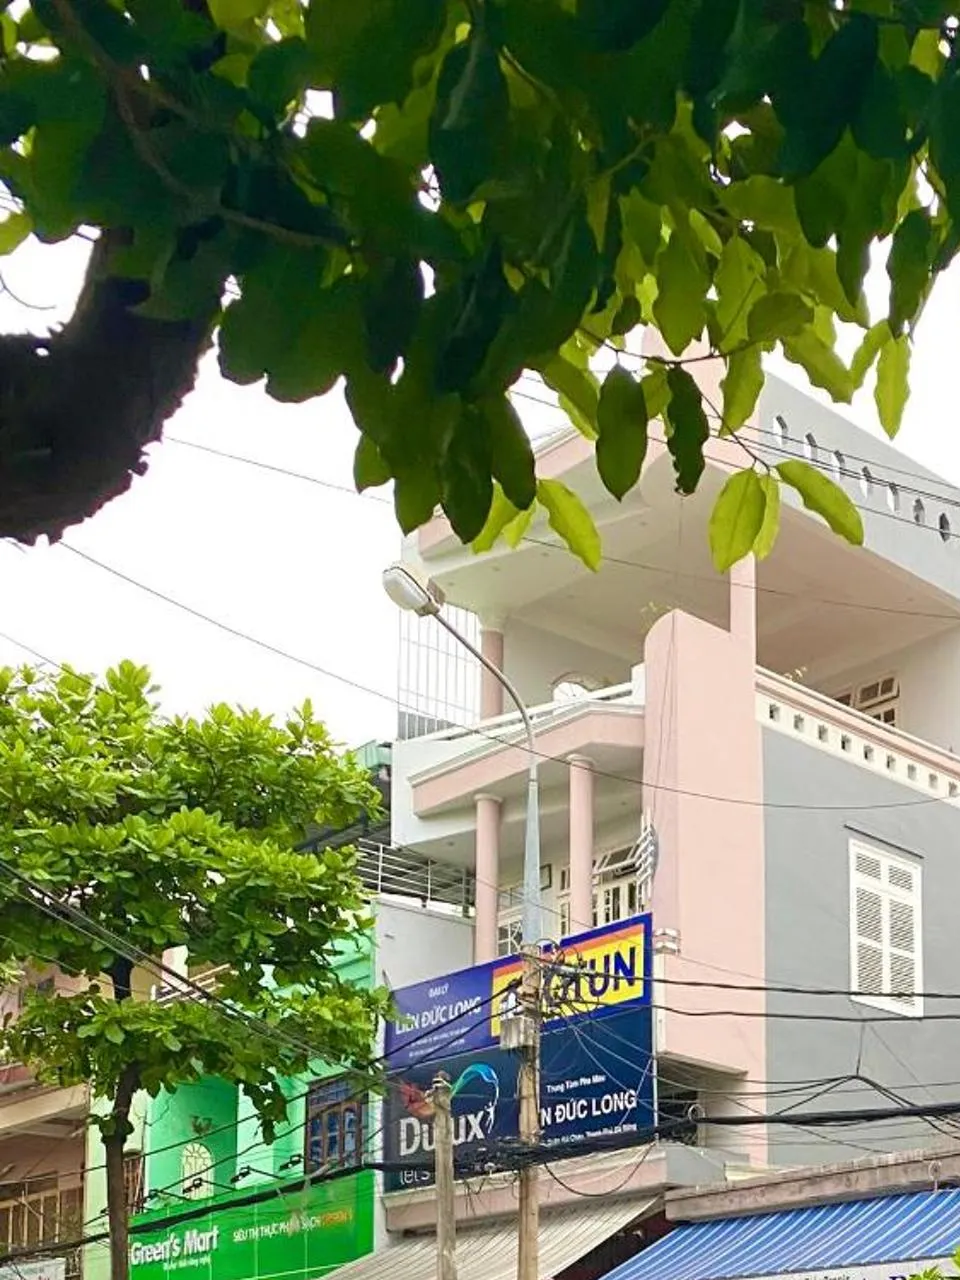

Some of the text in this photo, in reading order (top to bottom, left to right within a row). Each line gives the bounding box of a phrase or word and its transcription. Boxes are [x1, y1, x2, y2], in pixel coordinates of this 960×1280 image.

[591, 1089, 637, 1117] LONG
[400, 1110, 486, 1156] Duux
[131, 1232, 180, 1265] Green's
[184, 1225, 219, 1255] Mart
